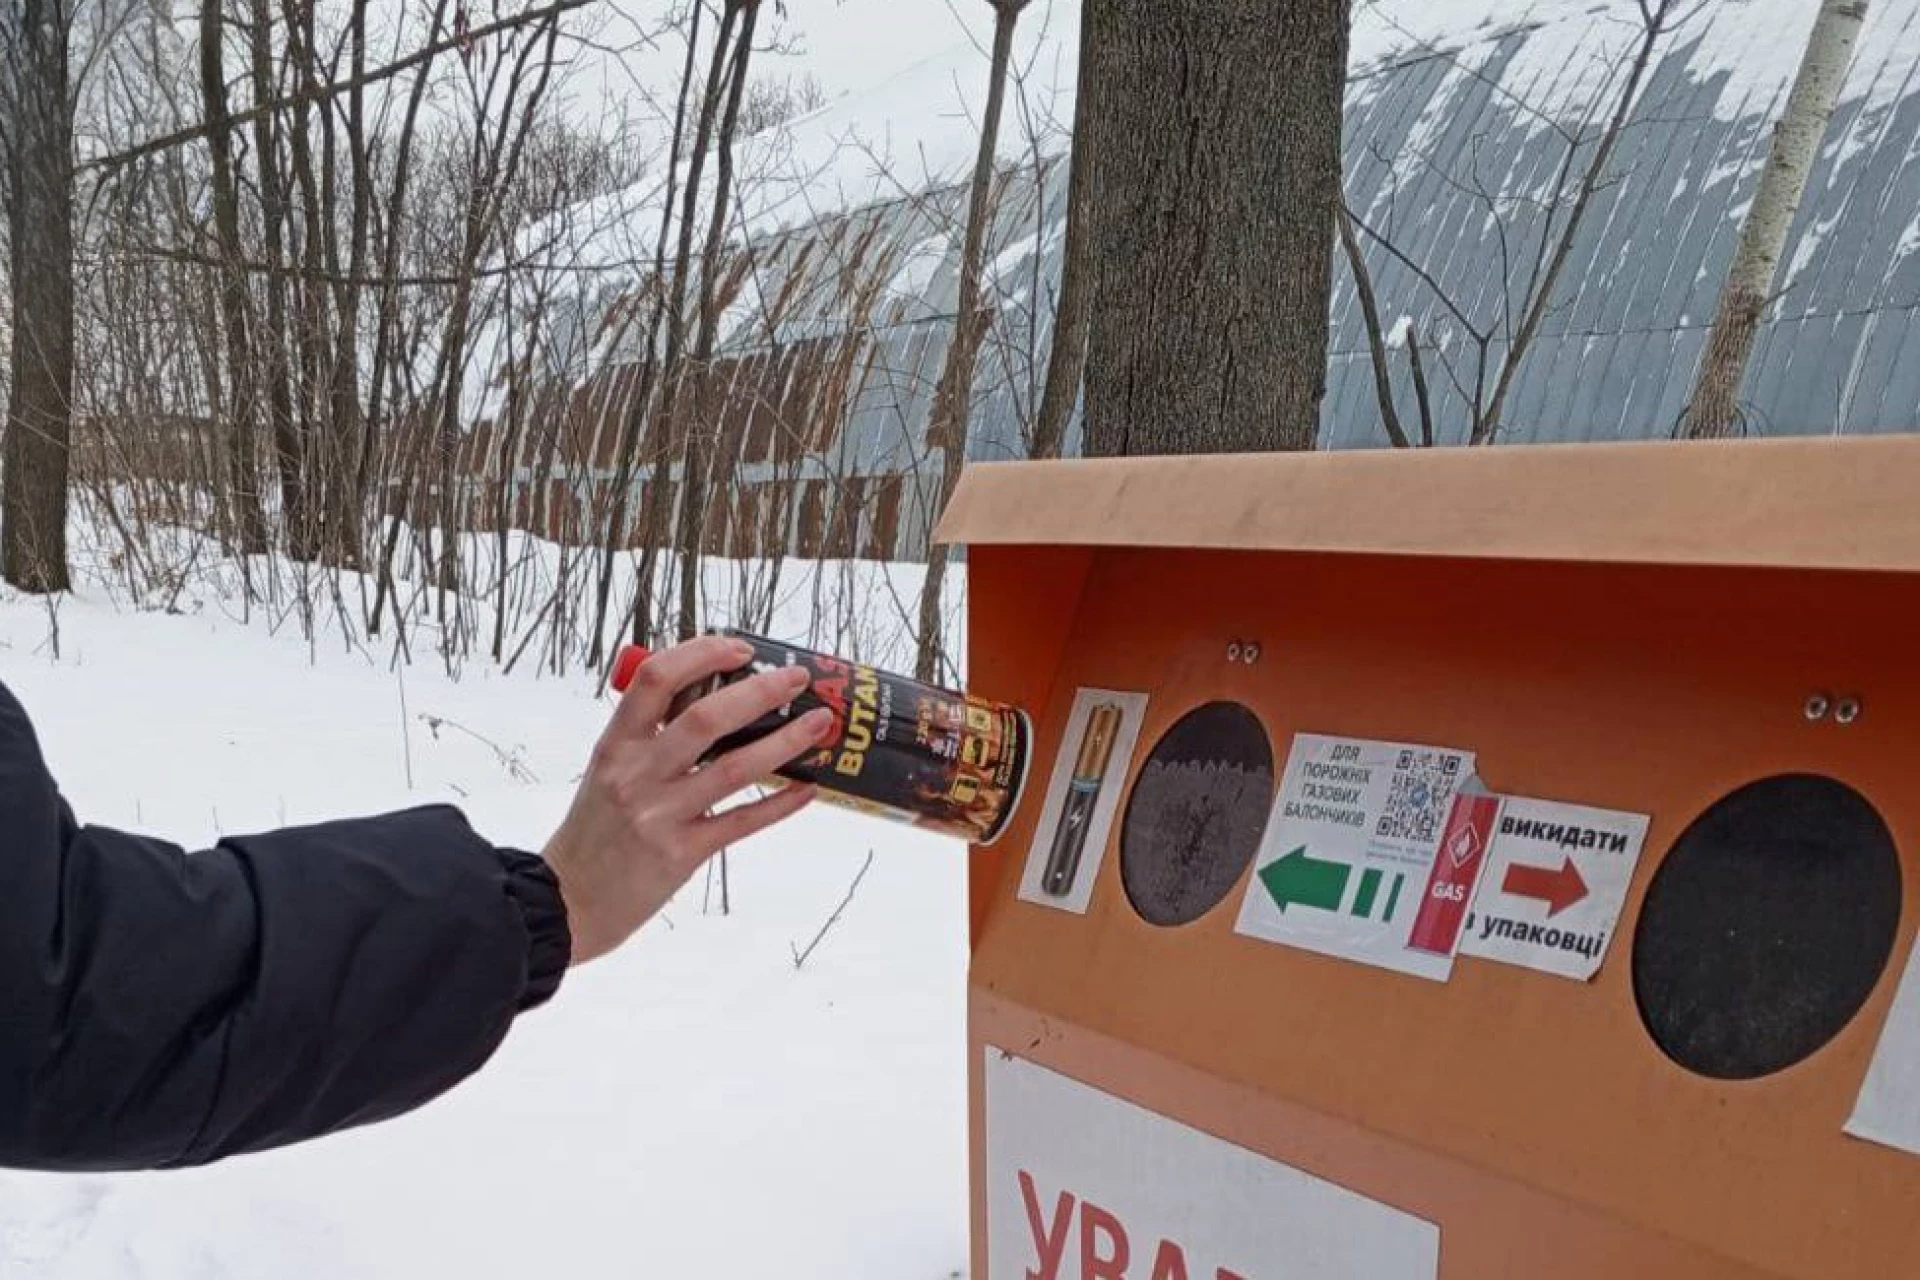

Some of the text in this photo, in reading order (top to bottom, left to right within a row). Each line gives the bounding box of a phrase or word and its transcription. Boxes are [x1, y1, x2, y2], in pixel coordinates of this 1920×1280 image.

[1329, 744, 1361, 762] ДЛЯ
[1301, 783, 1361, 804] ГАЗОВИХ
[1431, 880, 1465, 903] GAS
[1479, 914, 1604, 960] упаковці
[1018, 1169, 1252, 1280] УВ
